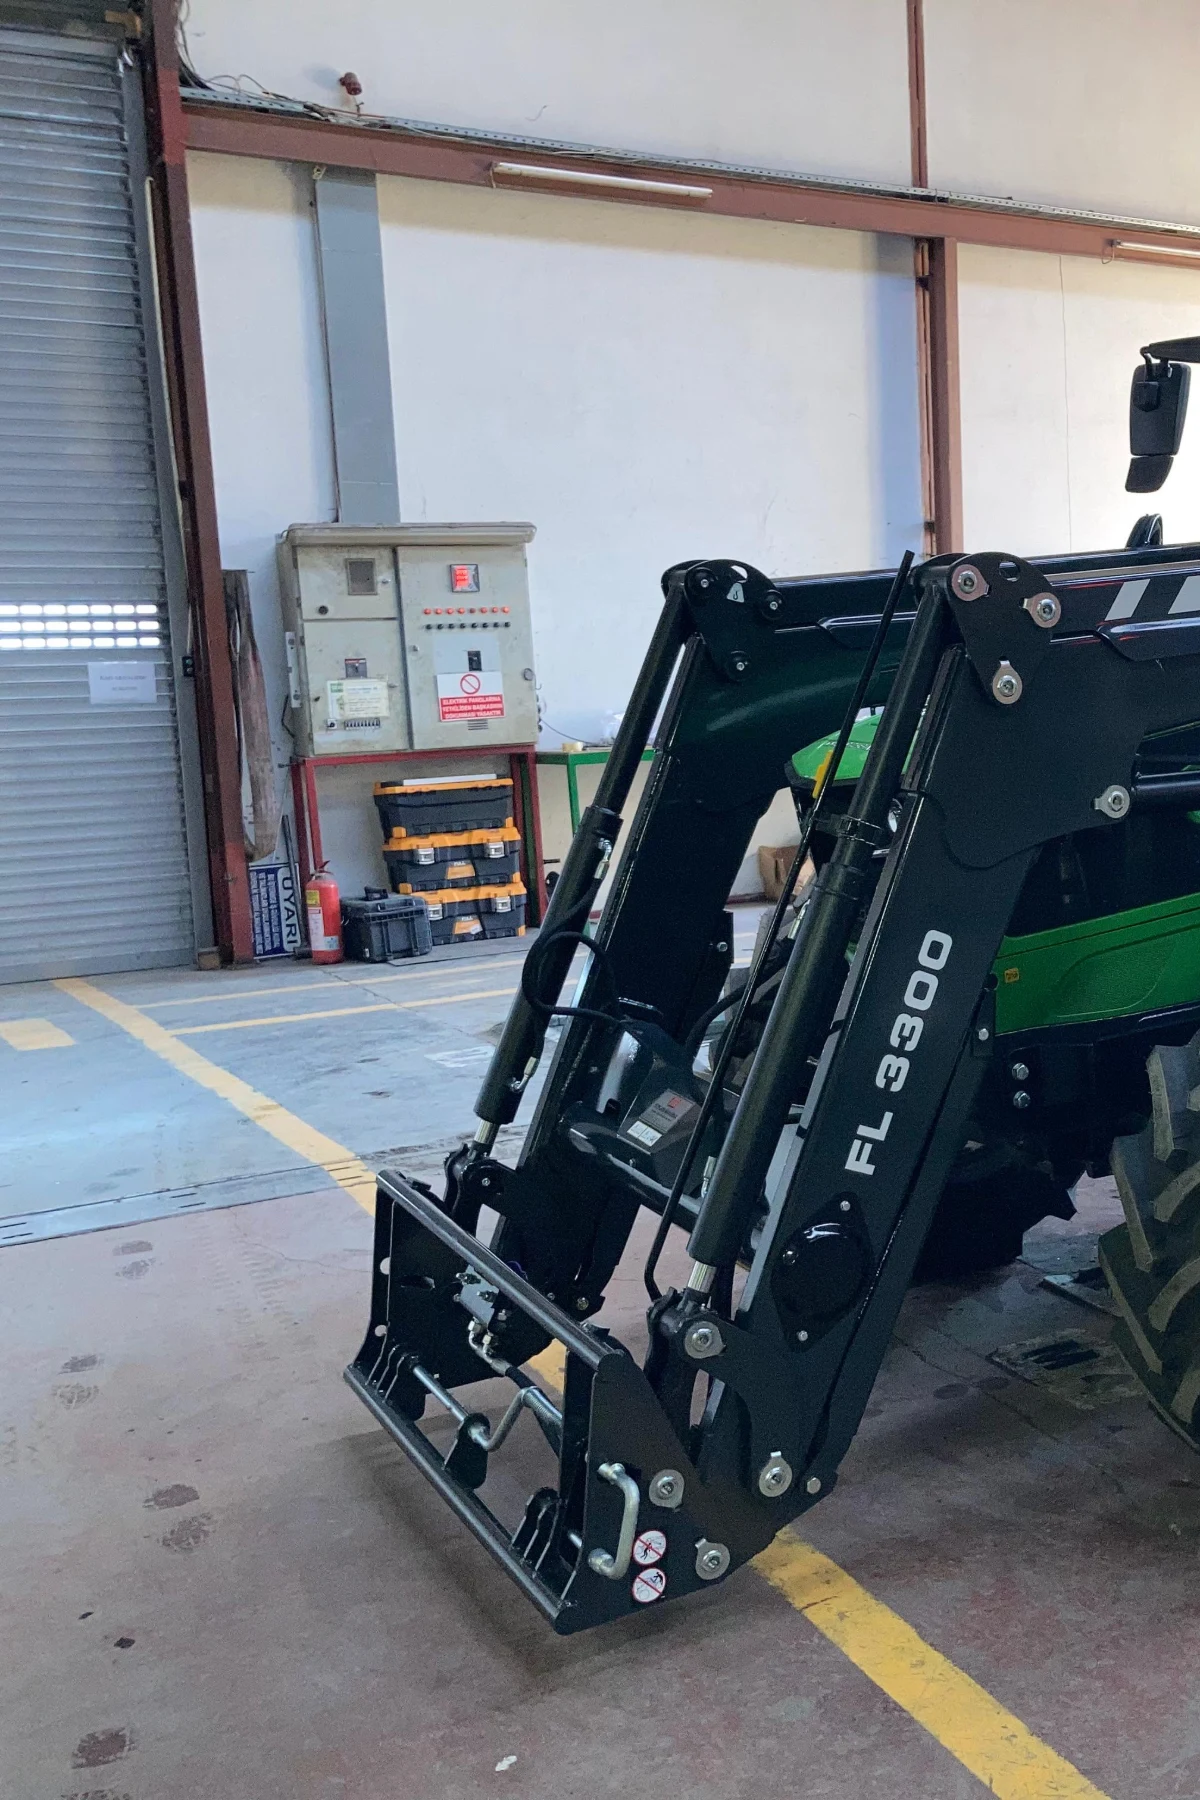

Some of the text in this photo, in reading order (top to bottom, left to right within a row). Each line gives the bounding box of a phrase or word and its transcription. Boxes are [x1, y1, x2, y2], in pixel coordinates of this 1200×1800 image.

[281, 876, 298, 945] UYARI
[844, 929, 953, 1176] FL 3300
